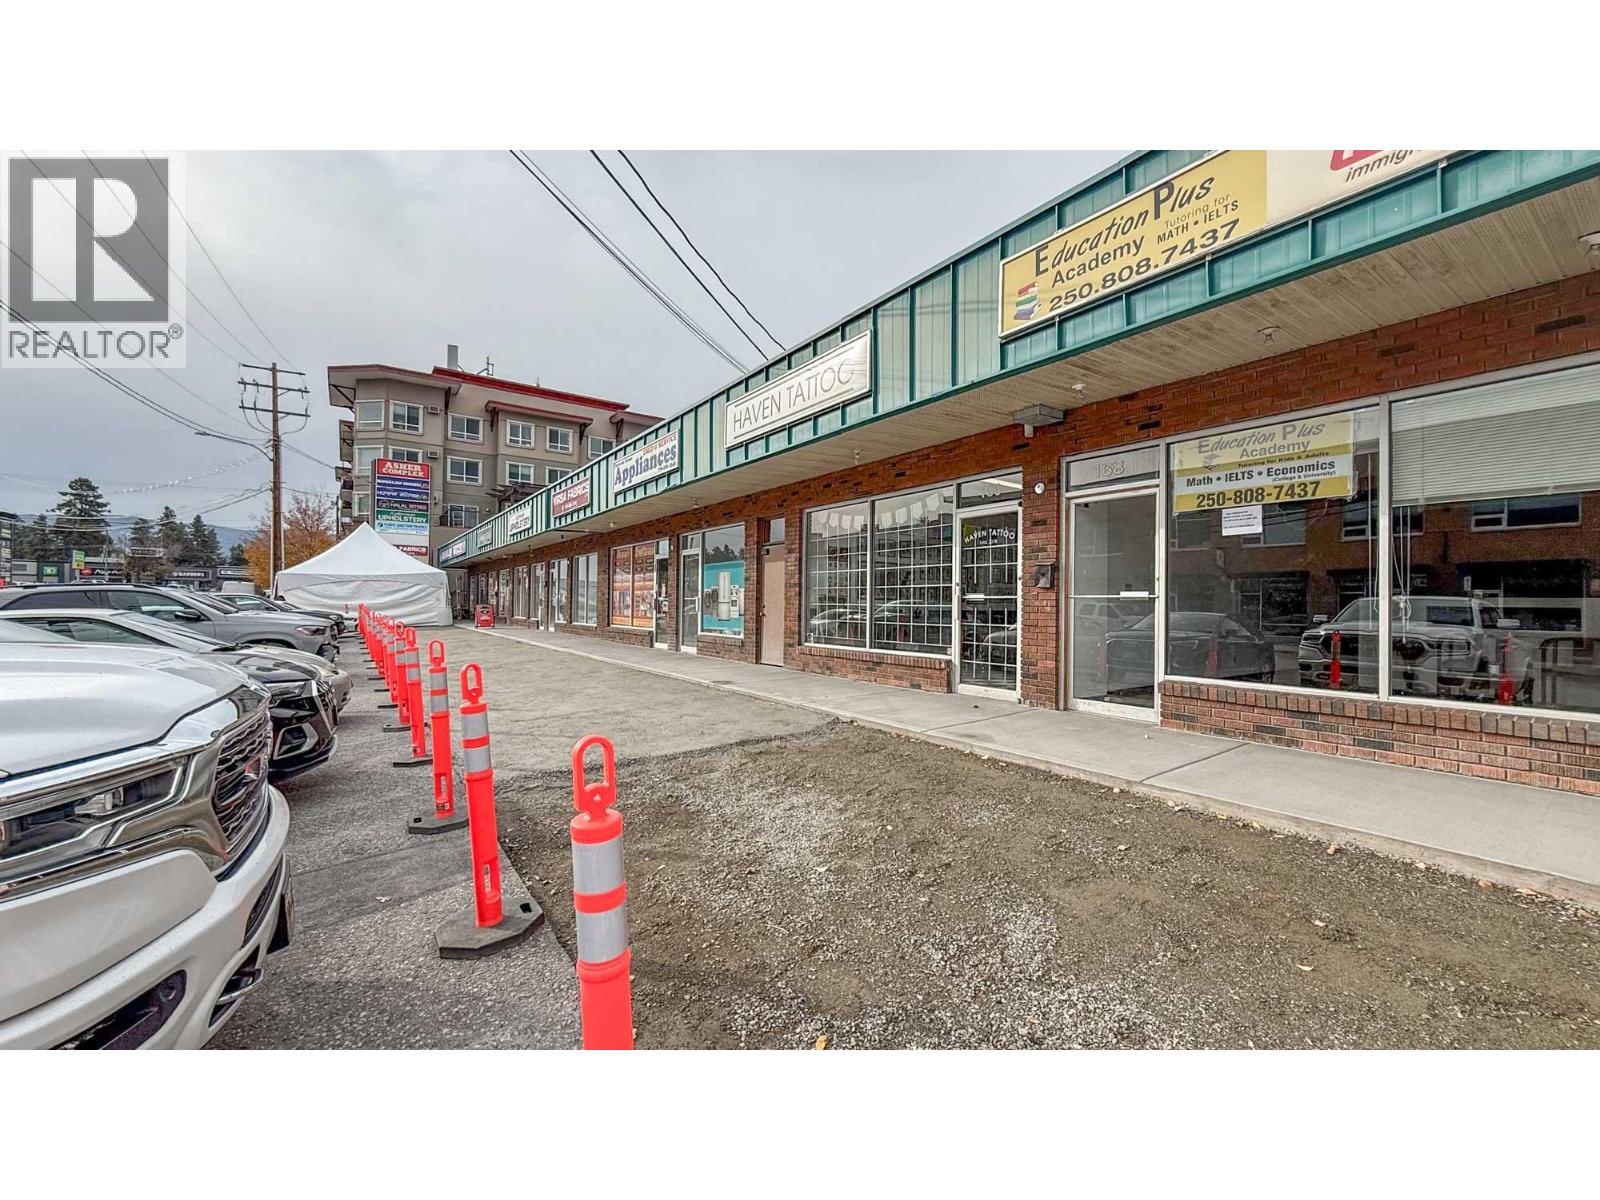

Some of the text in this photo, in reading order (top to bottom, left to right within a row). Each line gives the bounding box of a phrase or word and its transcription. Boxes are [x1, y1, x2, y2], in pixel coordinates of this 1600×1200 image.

[1345, 150, 1421, 183] immigr
[1157, 200, 1239, 244] MATH IELTS
[1165, 193, 1232, 229] Tutoring for
[1035, 176, 1215, 277] Education Plus
[1049, 218, 1240, 312] 250.808.7437
[1051, 236, 1144, 288] Academy
[733, 391, 781, 433] HAVEN
[1197, 421, 1325, 455] Education Plus
[1239, 440, 1311, 460] Academy
[382, 467, 424, 477] COMPLEX
[385, 461, 422, 472] ASHER
[614, 445, 677, 486] Appliances
[1186, 460, 1335, 487] Math IELTS Economics
[1238, 459, 1265, 468] Tutoring
[1278, 455, 1295, 463] Kids
[1304, 451, 1330, 460] Adults
[567, 481, 590, 500] FABRICS
[1196, 480, 1321, 508] 250-808-7437
[378, 514, 428, 523] UPHOLSTERY
[399, 545, 427, 554] FABRICS
[964, 529, 987, 544] HAVEN
[989, 527, 1015, 540] TATTOO
